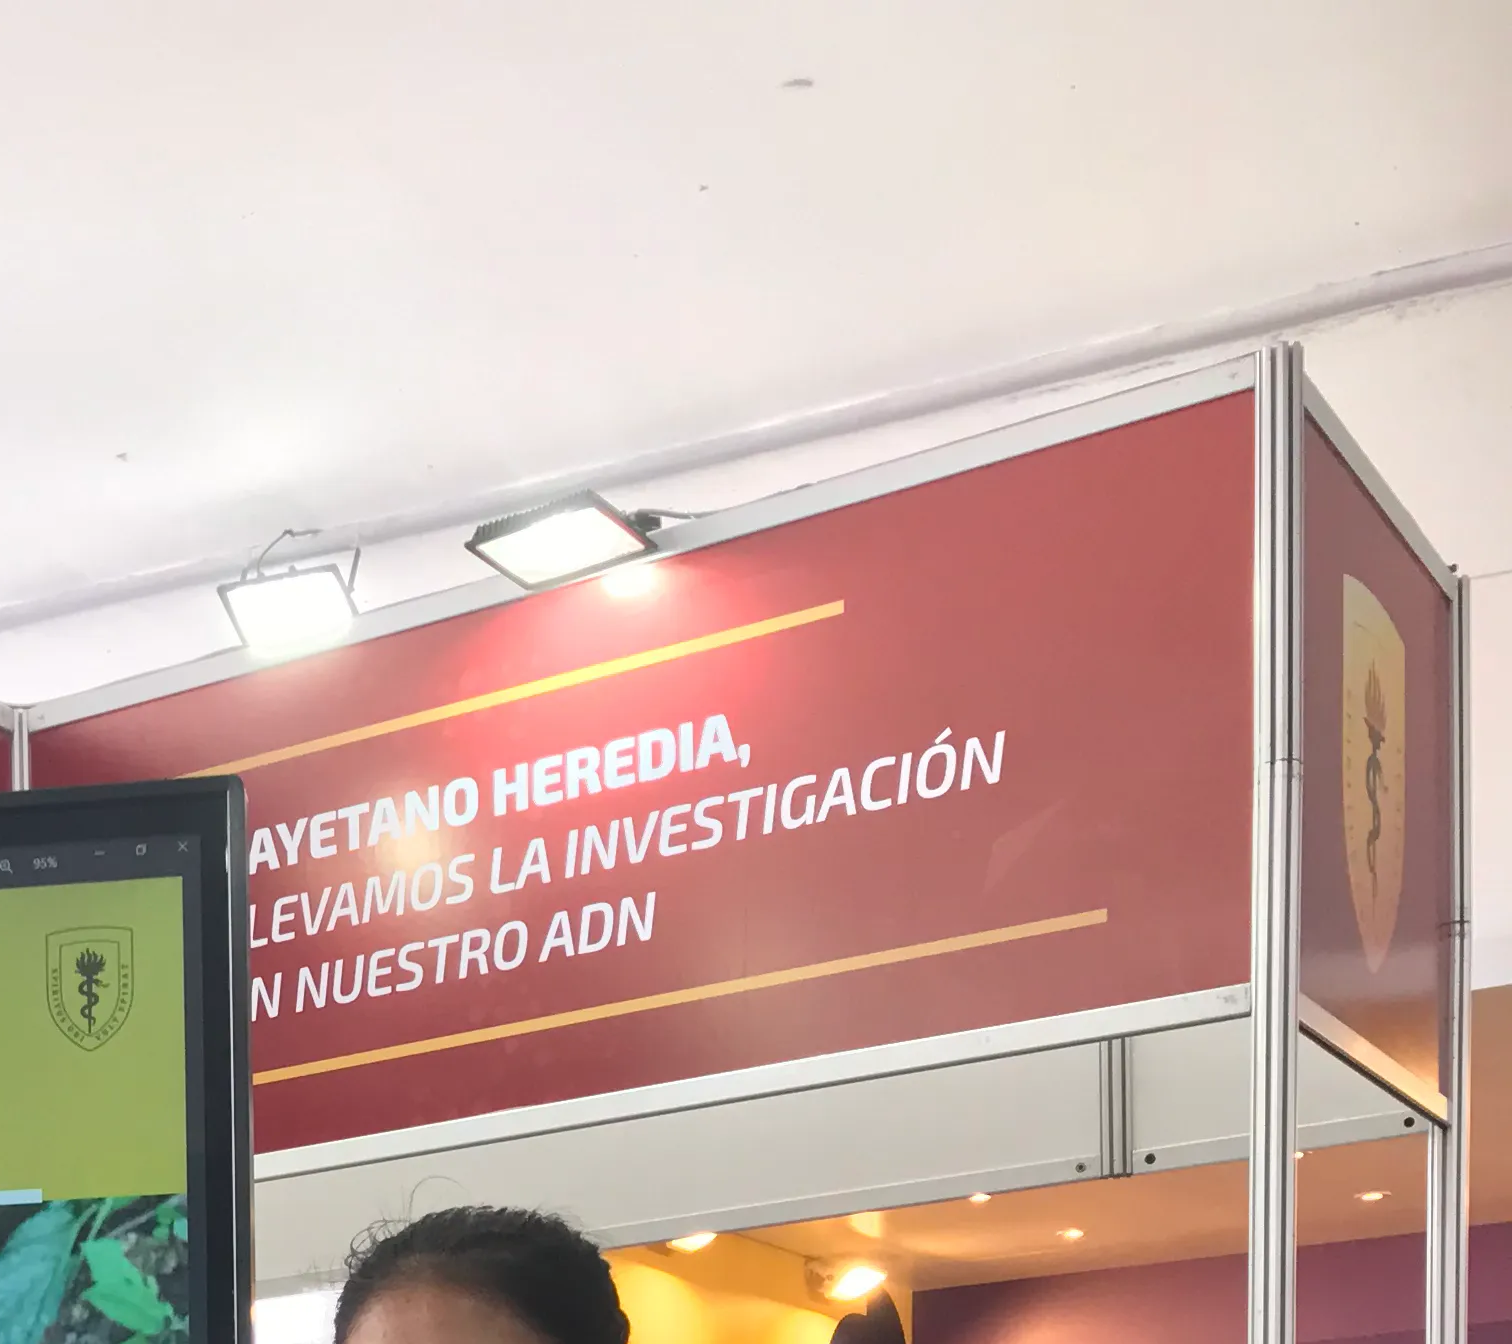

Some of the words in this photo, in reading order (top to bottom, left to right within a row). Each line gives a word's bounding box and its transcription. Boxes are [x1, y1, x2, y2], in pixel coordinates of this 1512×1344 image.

[249, 777, 479, 875] AYETANO
[492, 711, 752, 817] HEREDIA,
[249, 854, 476, 949] LEVAMOS
[489, 837, 550, 895] LA
[562, 727, 1008, 880] INVESTIGACIÓN
[251, 971, 283, 1022] N
[295, 920, 529, 1014] NUESTRO
[539, 889, 657, 965] ADN
